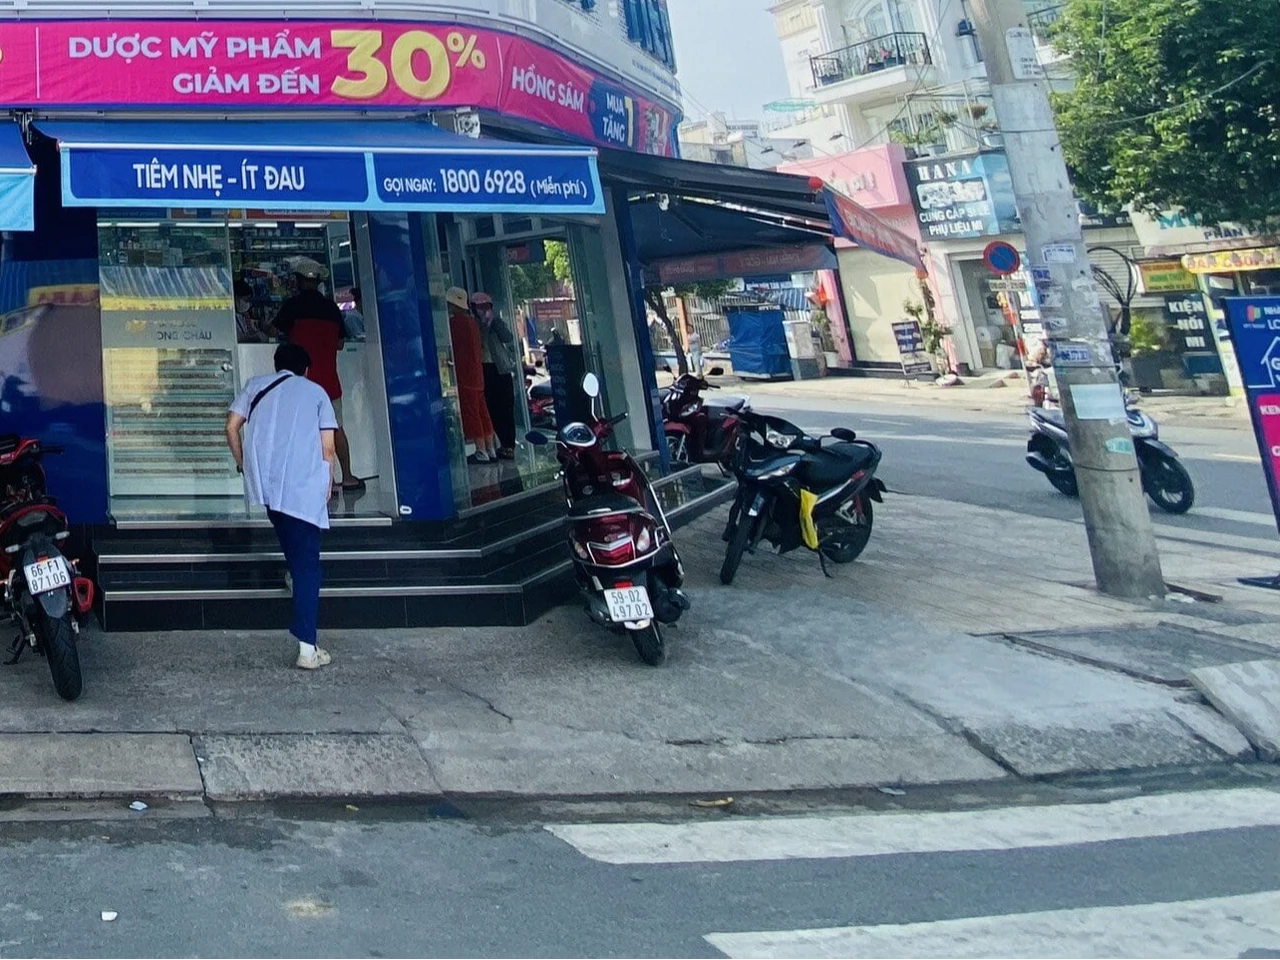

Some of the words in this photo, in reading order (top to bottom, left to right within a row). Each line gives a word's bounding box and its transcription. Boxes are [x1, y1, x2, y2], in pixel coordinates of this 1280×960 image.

[68, 36, 162, 64] DƯỢC
[170, 30, 219, 59] MỸ
[227, 30, 321, 59] PHẨM
[330, 29, 487, 100] 30%
[173, 70, 251, 95] GIẢM
[257, 67, 320, 95] ĐẾN
[511, 64, 557, 103] HỒNG
[557, 80, 585, 114] SÂM
[606, 92, 625, 117] MUA
[602, 114, 626, 143] TẶNG
[133, 158, 179, 190] TIÊM
[183, 165, 222, 194] NHẸ
[241, 158, 260, 191] ÍT
[264, 165, 305, 191] ĐAU
[383, 178, 405, 197] GỌI
[405, 179, 437, 195] NGAY:
[440, 168, 479, 194] 1800
[484, 169, 525, 195] 6928
[917, 160, 972, 181] HANA
[919, 210, 945, 223] CUNG
[971, 219, 984, 232] MI
